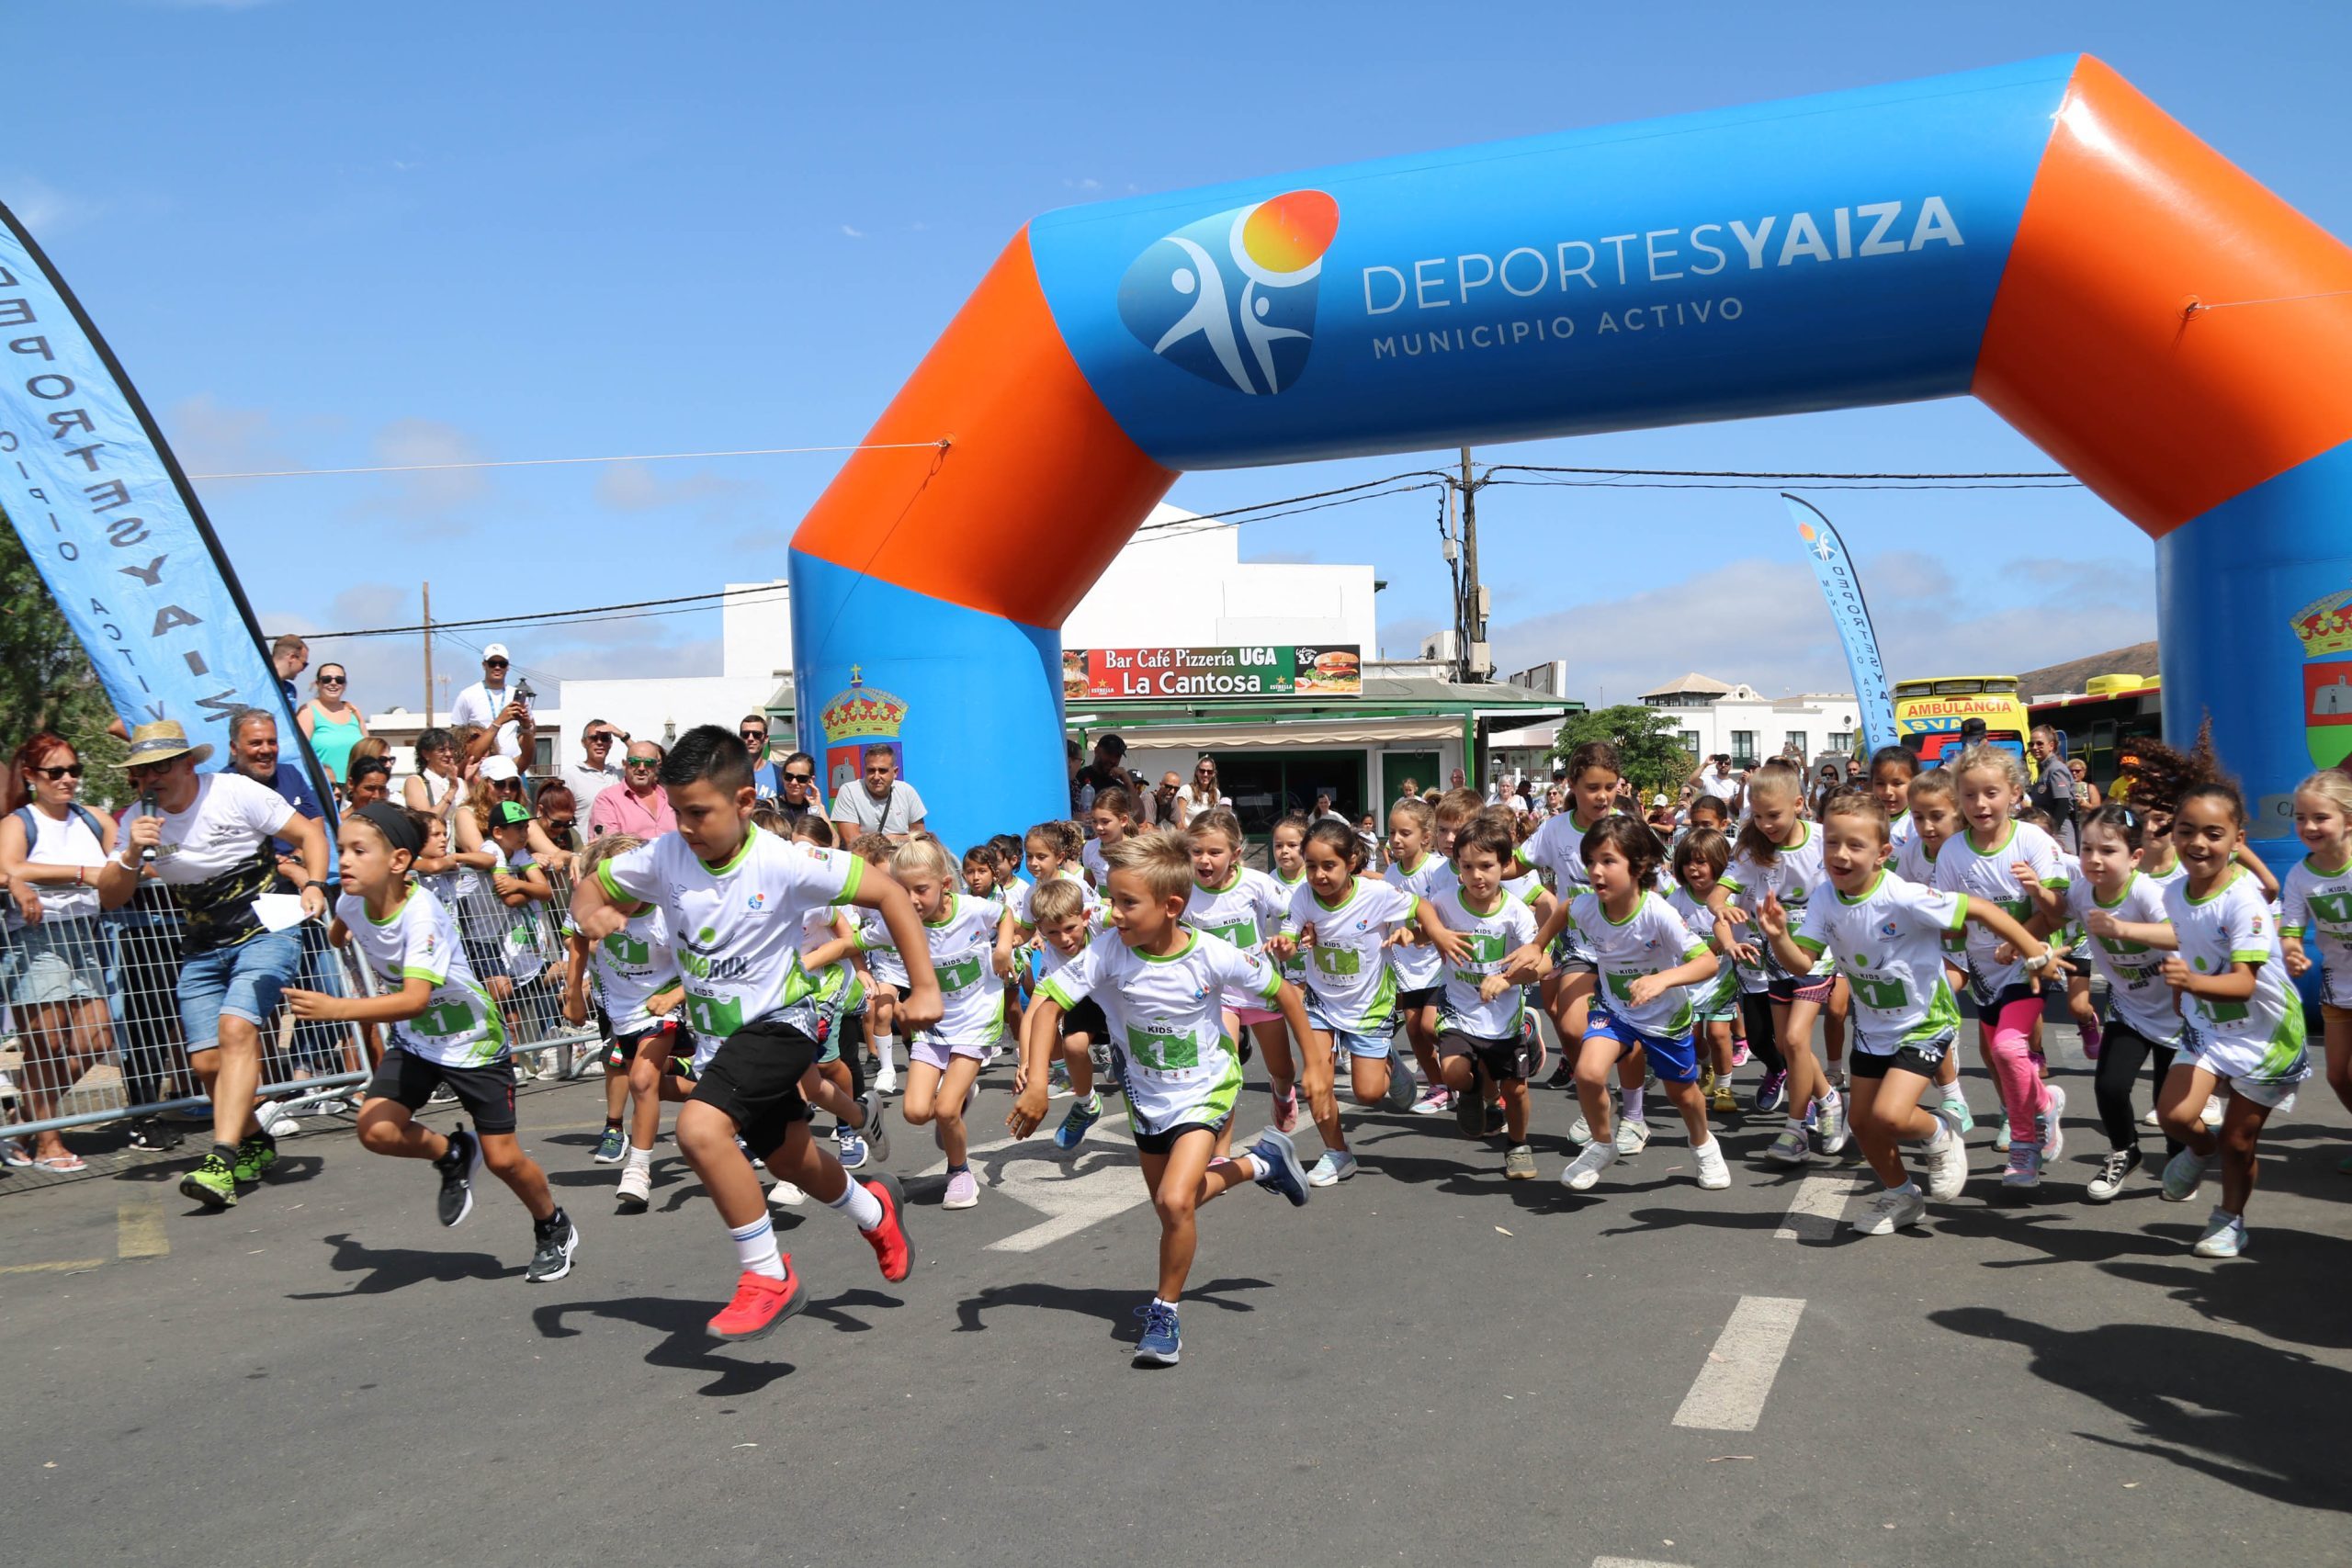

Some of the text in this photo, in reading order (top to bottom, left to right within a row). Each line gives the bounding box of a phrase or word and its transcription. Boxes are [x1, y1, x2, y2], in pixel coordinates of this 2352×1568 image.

[1363, 196, 1964, 315] DEPORTESYAIZA
[1374, 297, 1743, 359] MUNICIPIO ACTIVO
[1105, 647, 1278, 669] Bar Café Pizzería UGA
[1123, 671, 1261, 694] La Cantosa
[1908, 701, 2011, 716] AMBULANCIA
[2331, 897, 2347, 919] 1
[1225, 928, 1238, 947] 1
[618, 940, 628, 959] 1
[1473, 940, 1485, 960] 1
[942, 958, 961, 966] KIDS
[1325, 952, 1337, 971] 1
[946, 970, 961, 987] 1
[693, 987, 714, 997] KIDS
[1863, 985, 1879, 1005] 1
[430, 1010, 447, 1032] 1
[695, 1002, 712, 1030] 1
[1148, 1026, 1173, 1034] KIDS
[1148, 1041, 1164, 1066] 1
